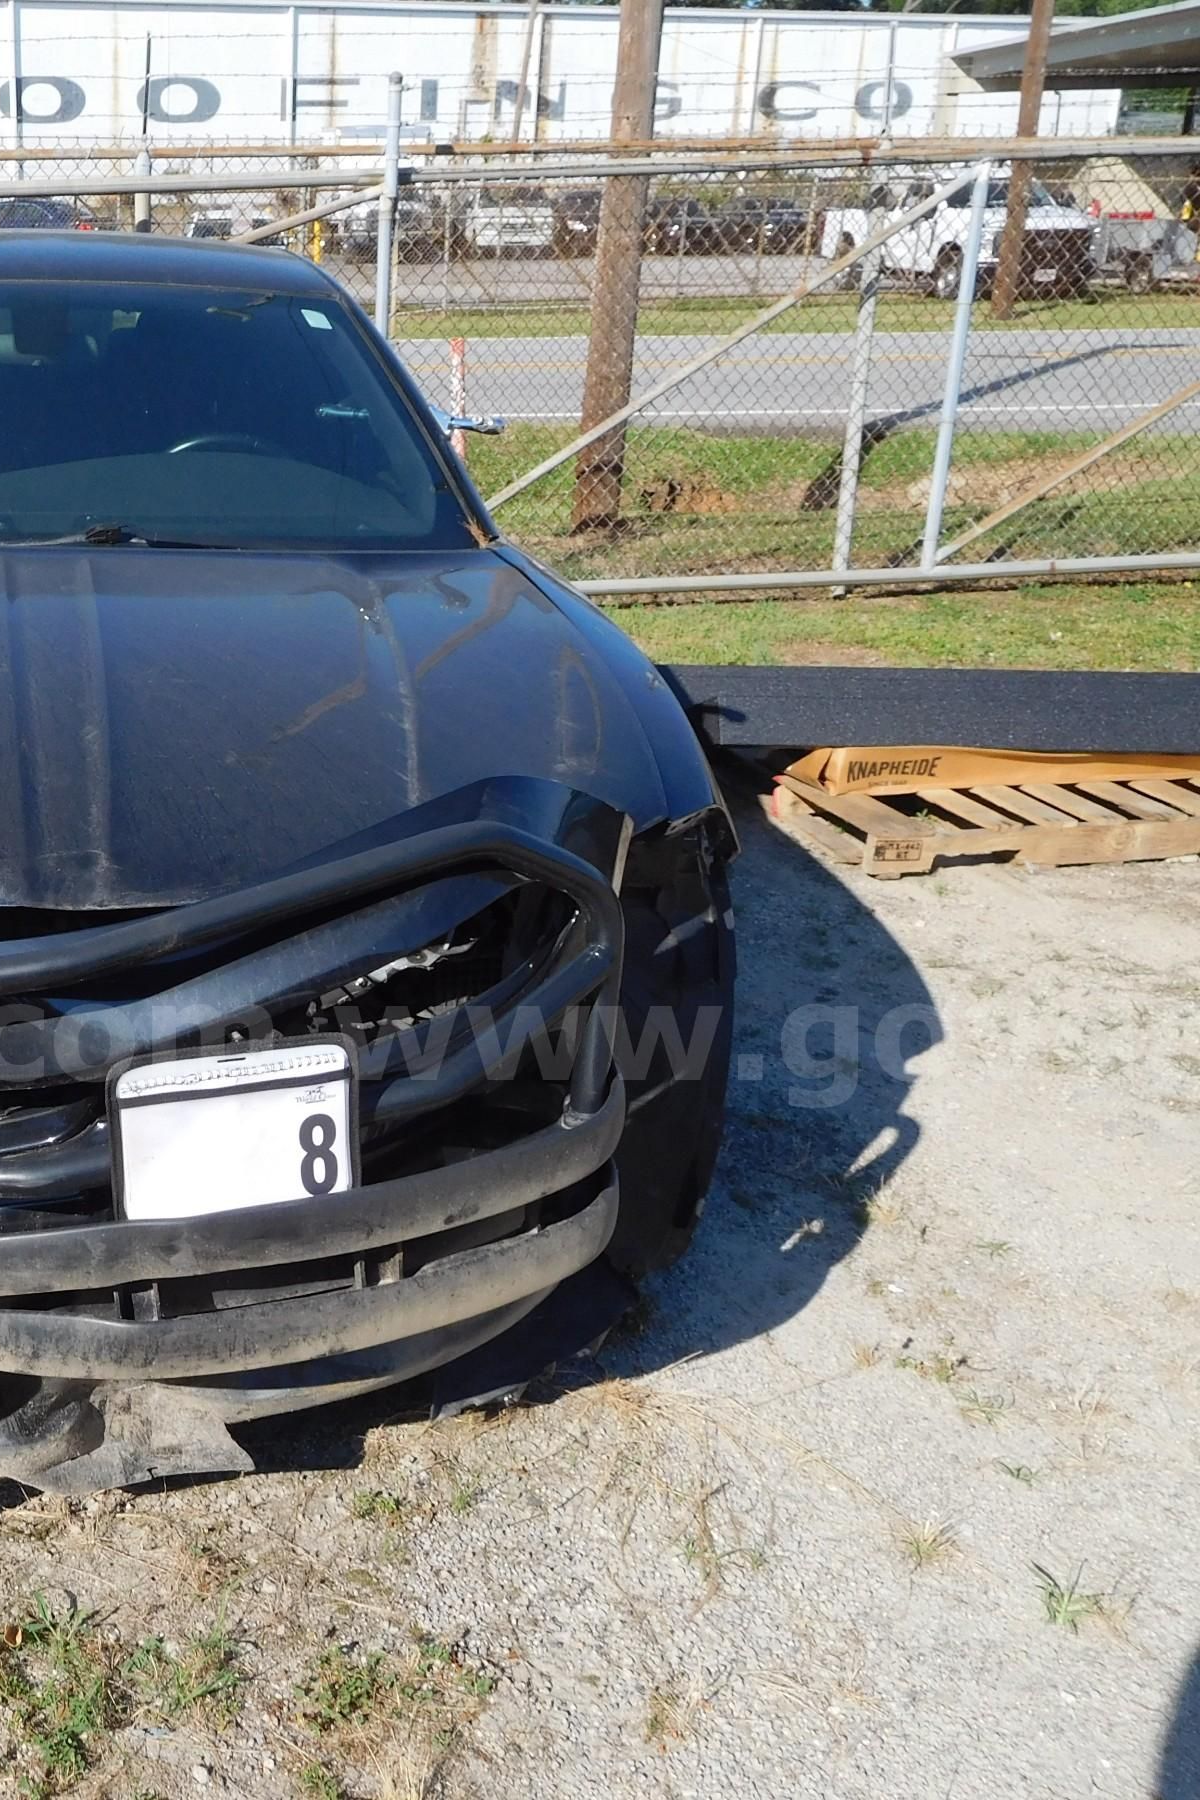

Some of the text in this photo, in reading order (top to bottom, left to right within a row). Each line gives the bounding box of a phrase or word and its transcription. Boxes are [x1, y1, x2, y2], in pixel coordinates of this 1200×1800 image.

[757, 79, 914, 122] CO
[846, 755, 943, 784] KNAPHEIDE
[299, 1113, 338, 1197] 8
